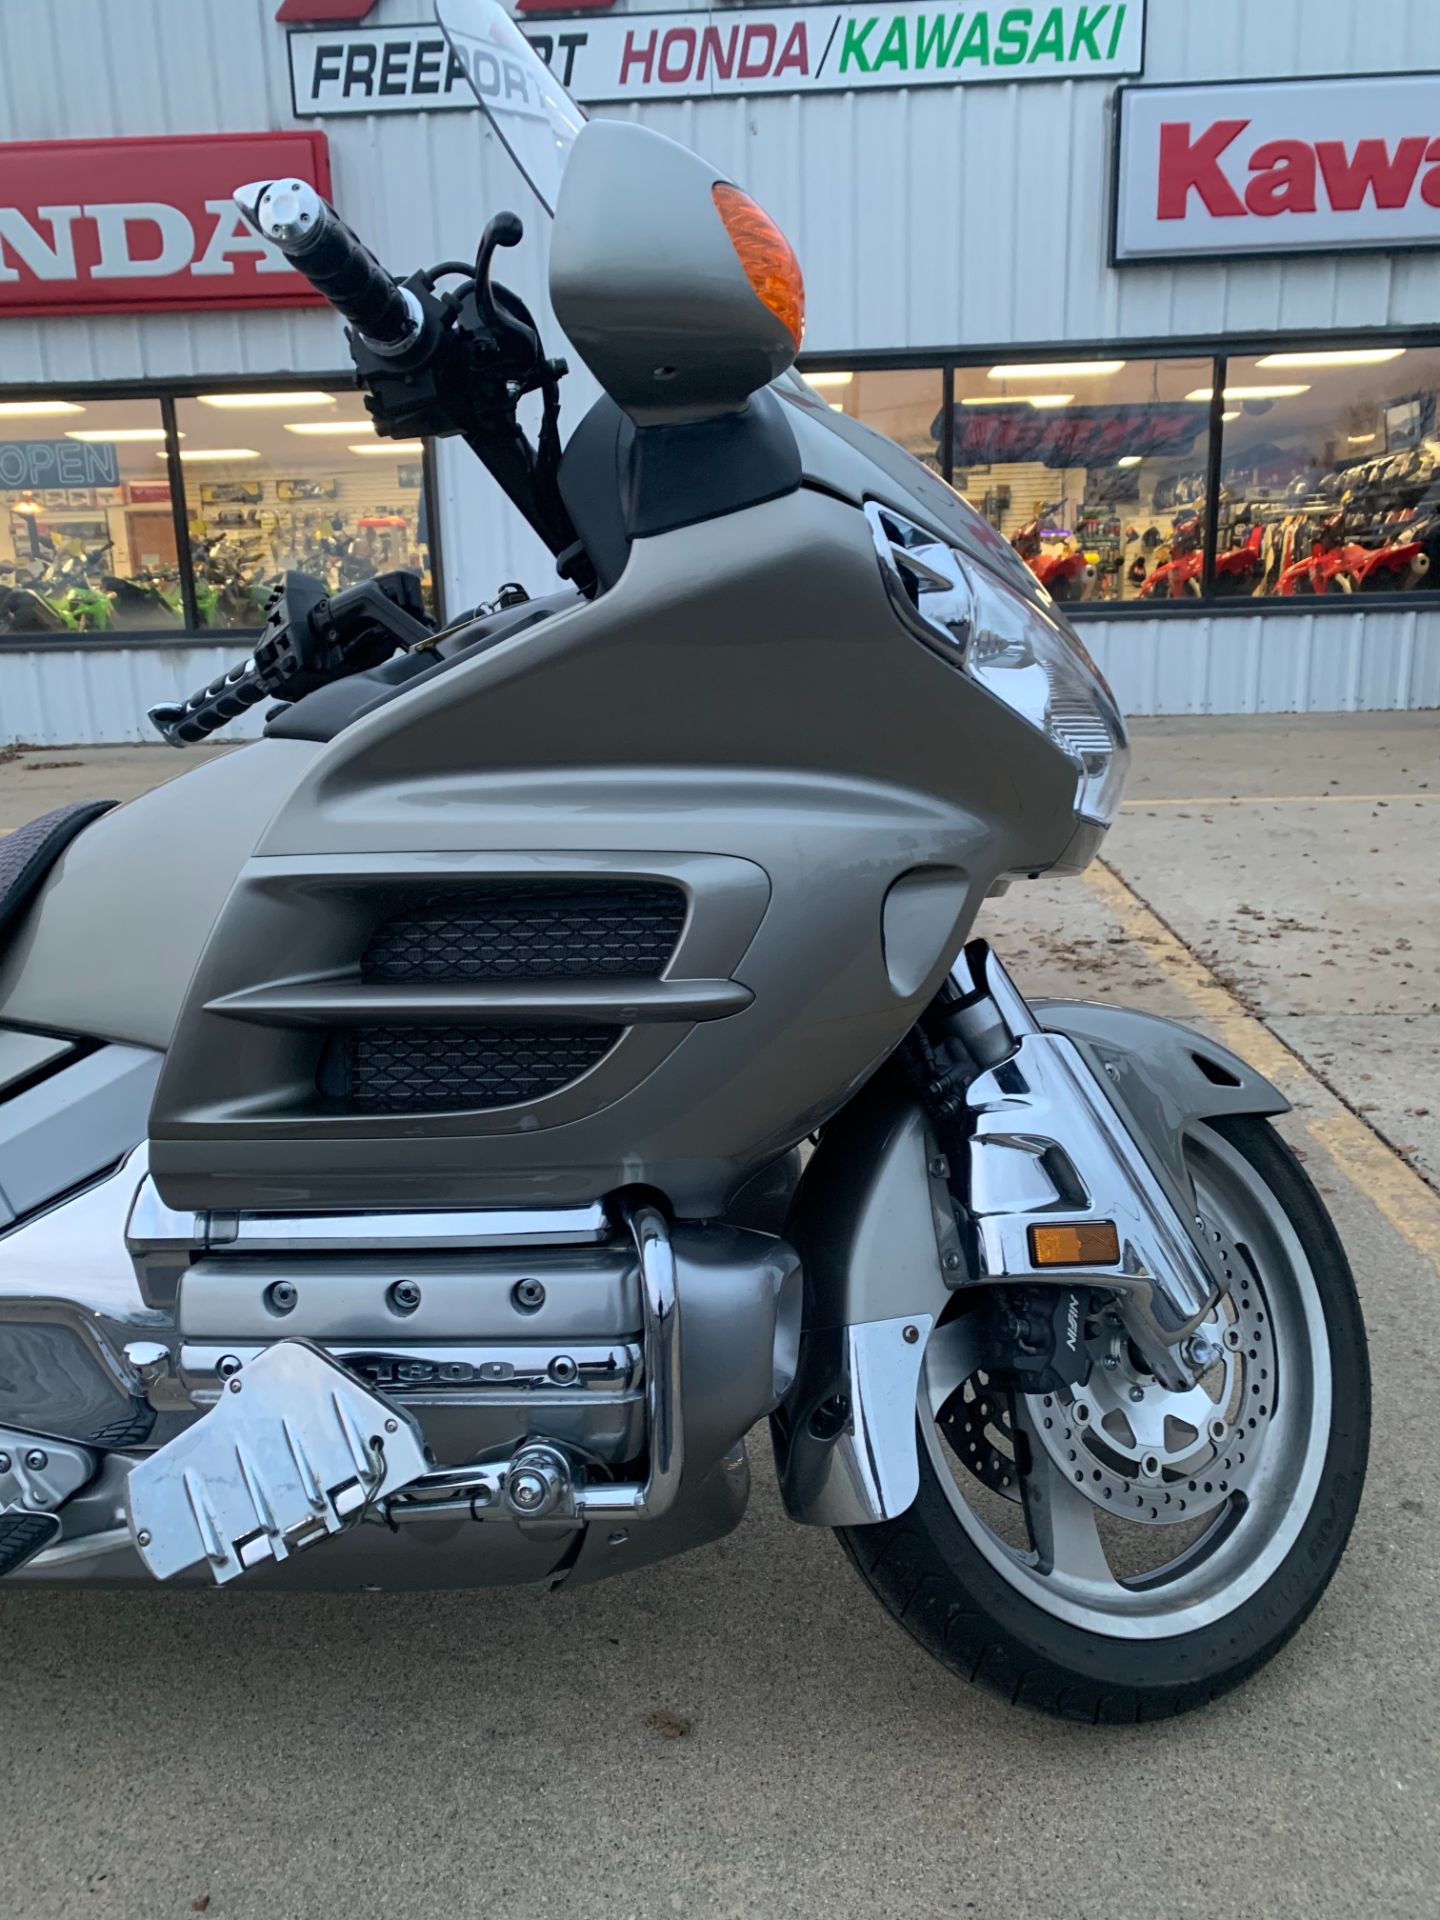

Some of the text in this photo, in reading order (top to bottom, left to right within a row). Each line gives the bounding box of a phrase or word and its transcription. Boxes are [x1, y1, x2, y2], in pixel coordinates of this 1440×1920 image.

[1157, 119, 1440, 220] Kaw
[0, 443, 115, 485] OPEN
[366, 1361, 515, 1381] 1800
